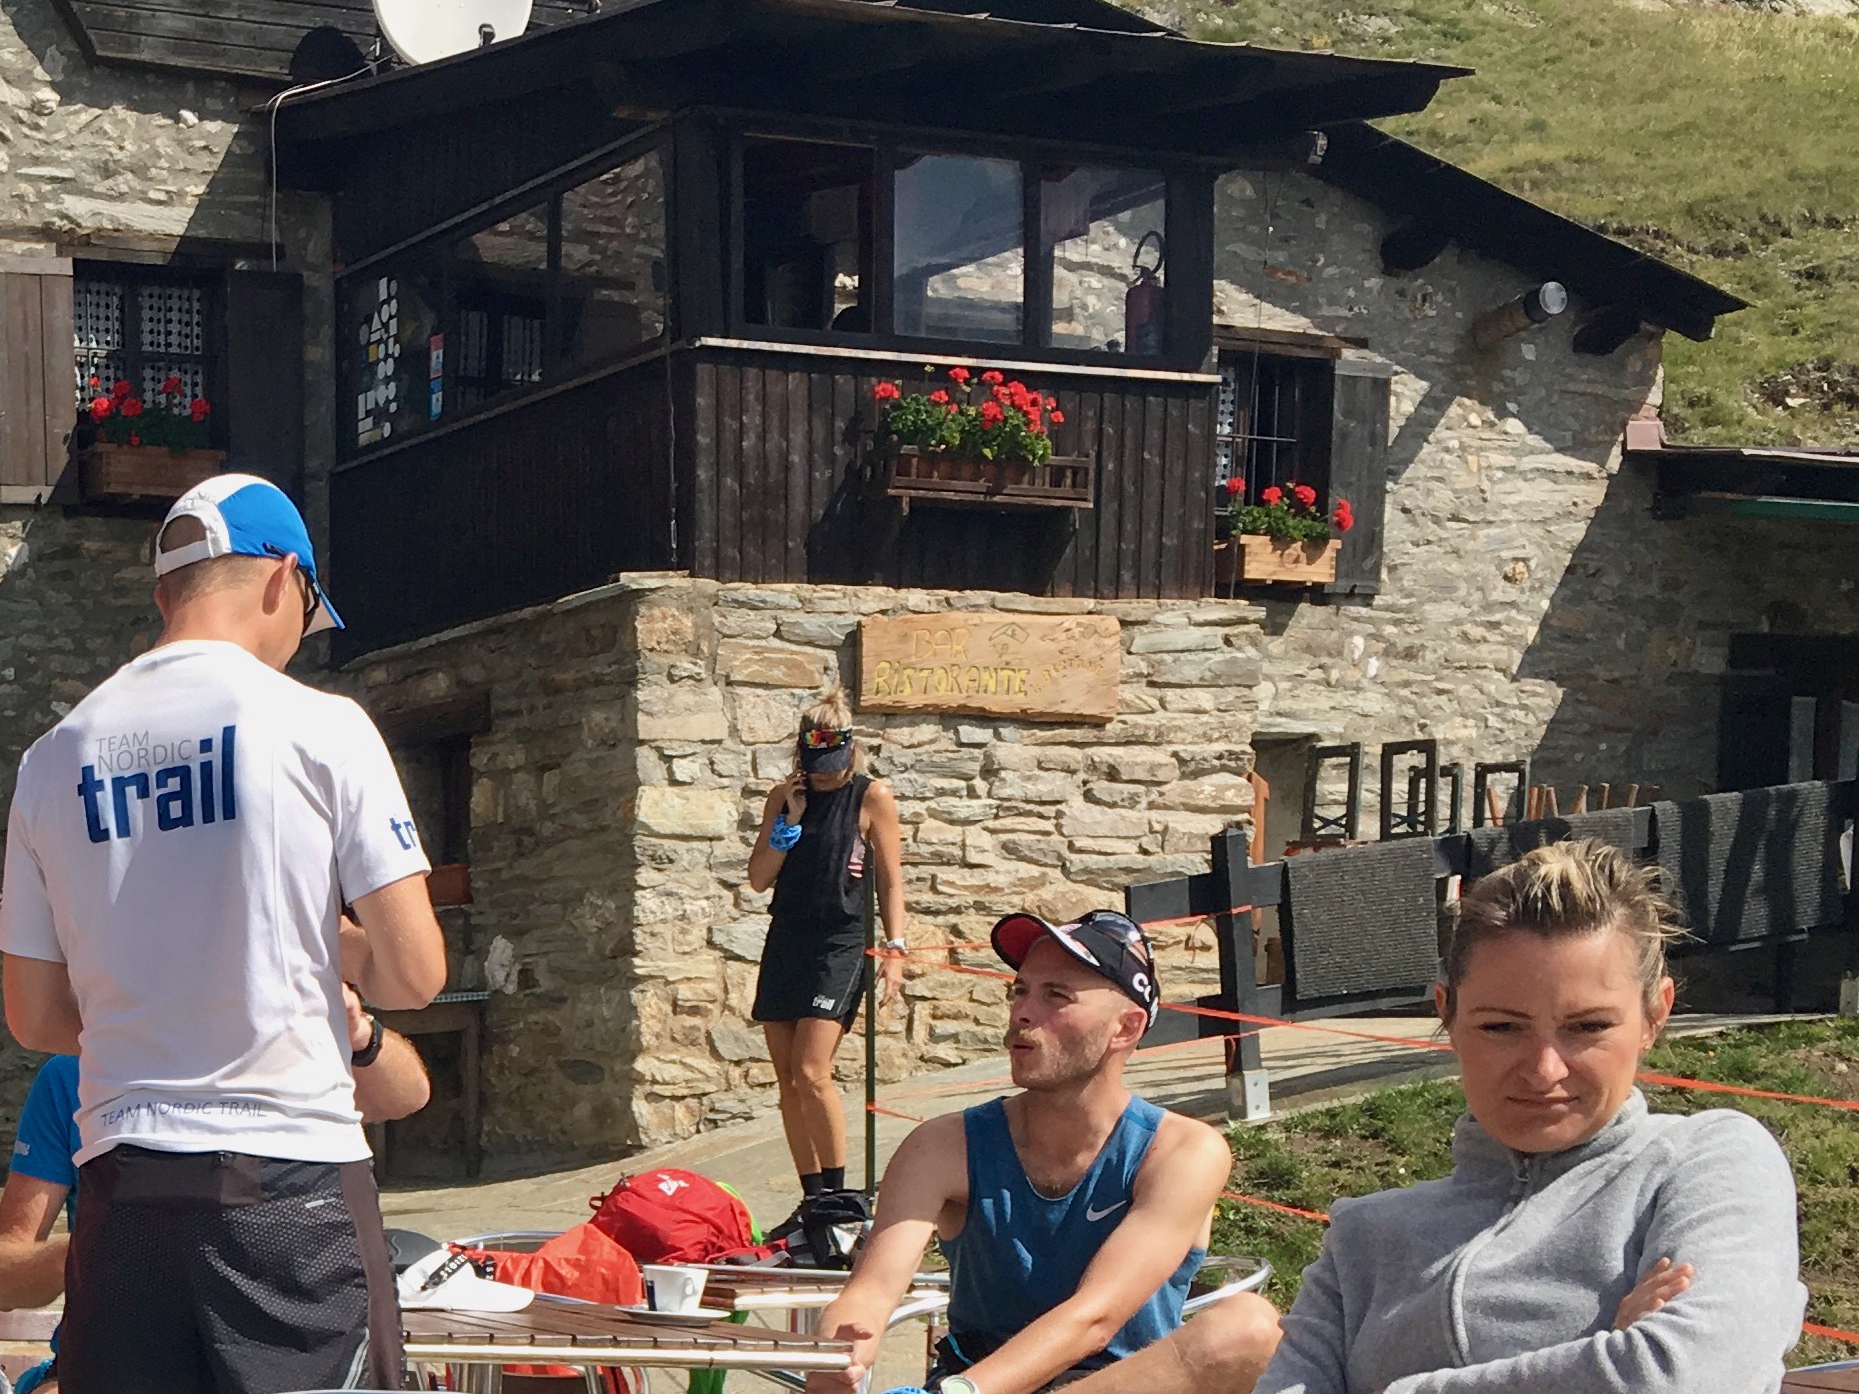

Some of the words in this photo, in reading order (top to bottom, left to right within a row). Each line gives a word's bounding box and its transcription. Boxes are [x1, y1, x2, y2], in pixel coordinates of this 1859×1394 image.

[912, 628, 970, 661] BAR
[96, 730, 149, 754] TEAM
[98, 740, 193, 775] NORDIC
[77, 725, 237, 844] trail
[100, 1103, 141, 1127] TEAM
[146, 1101, 213, 1116] NORDIC
[219, 1101, 268, 1118] TRAIL
